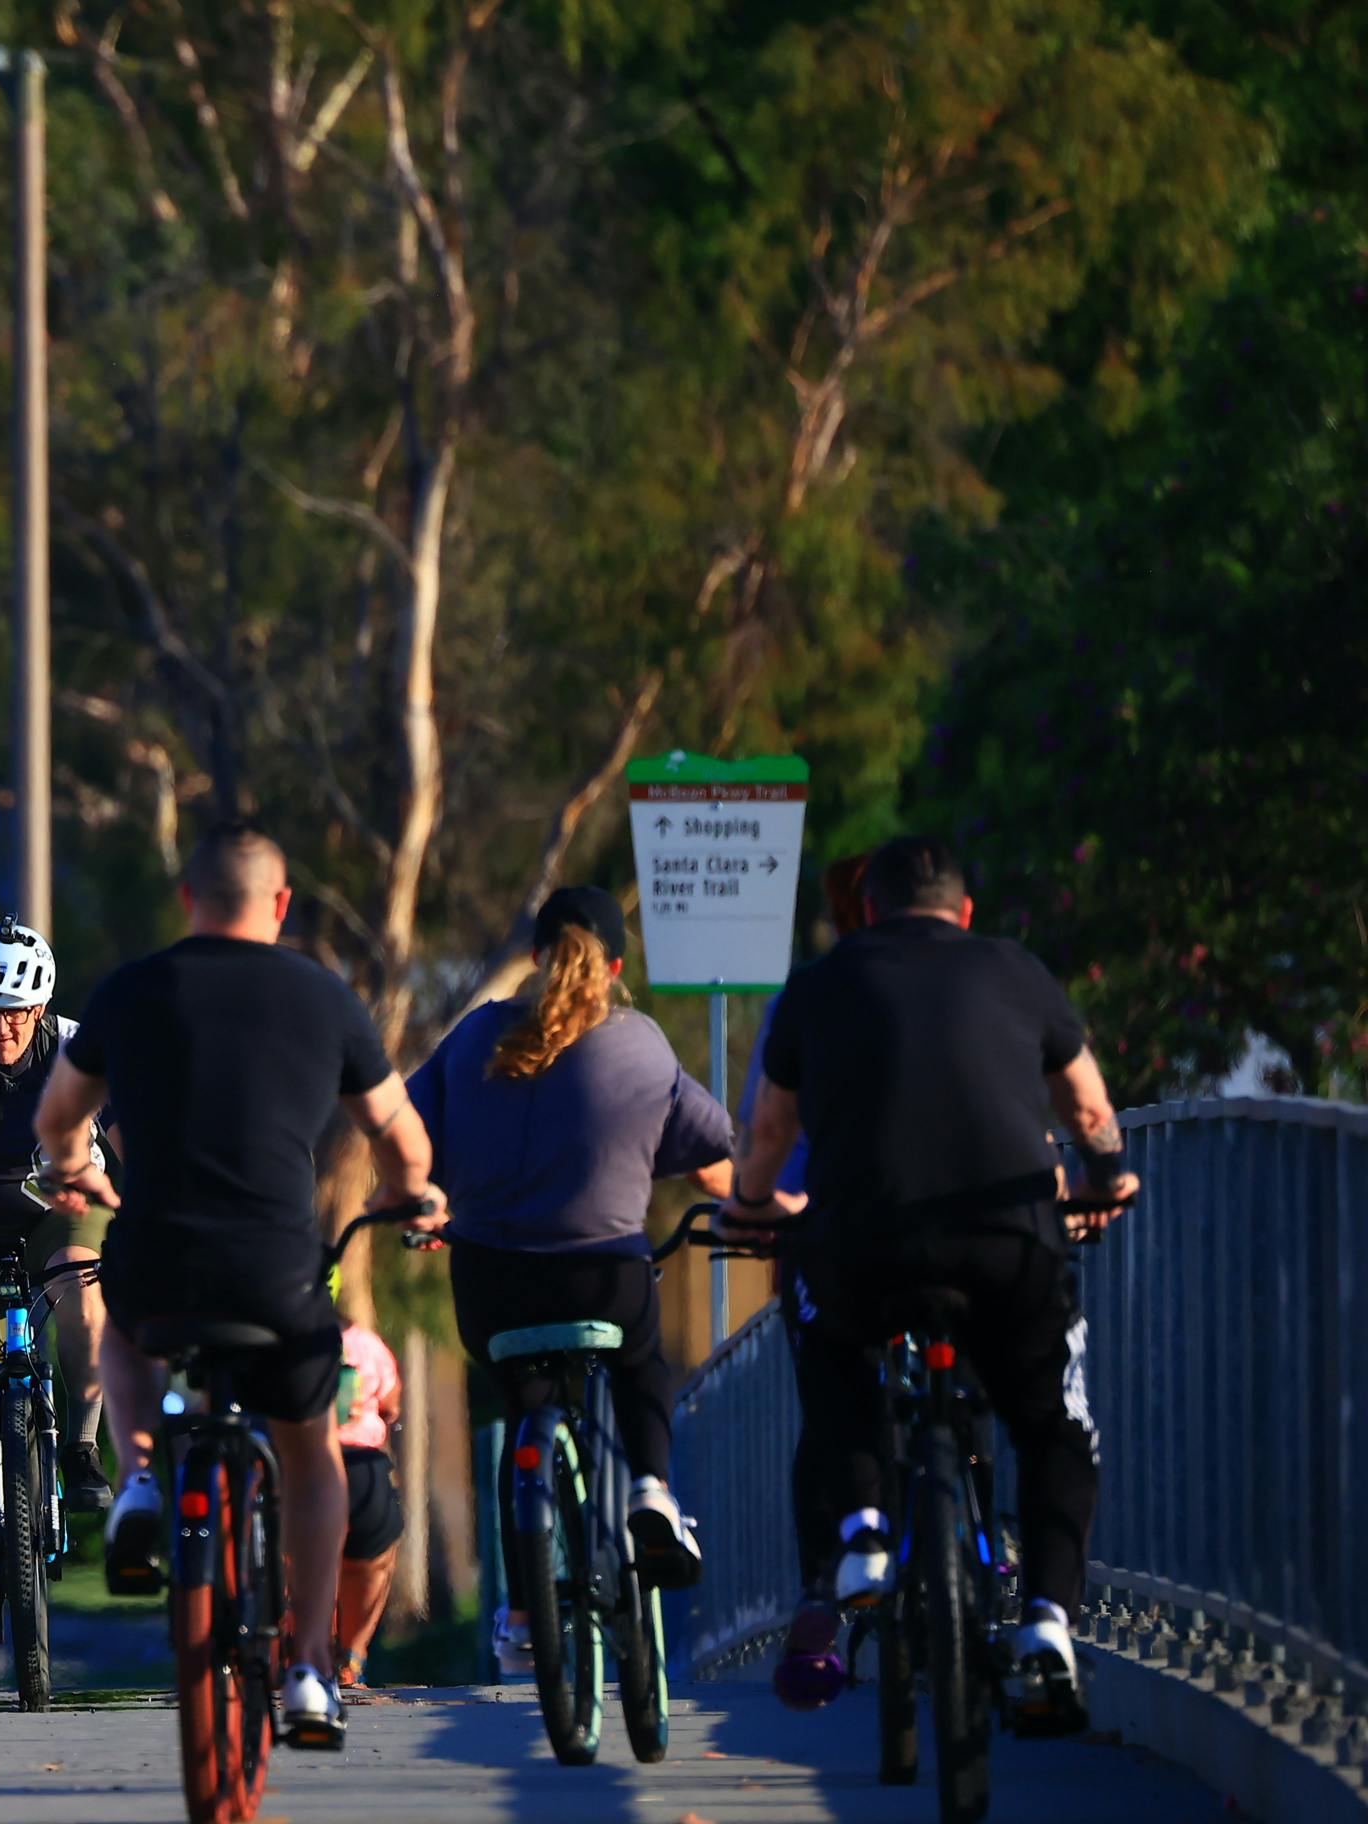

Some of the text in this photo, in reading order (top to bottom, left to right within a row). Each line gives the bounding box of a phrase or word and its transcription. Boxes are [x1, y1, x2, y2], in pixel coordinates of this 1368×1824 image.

[684, 817, 760, 840] Shopping
[653, 855, 749, 874] Santa Clara
[653, 879, 739, 896] River Trail
